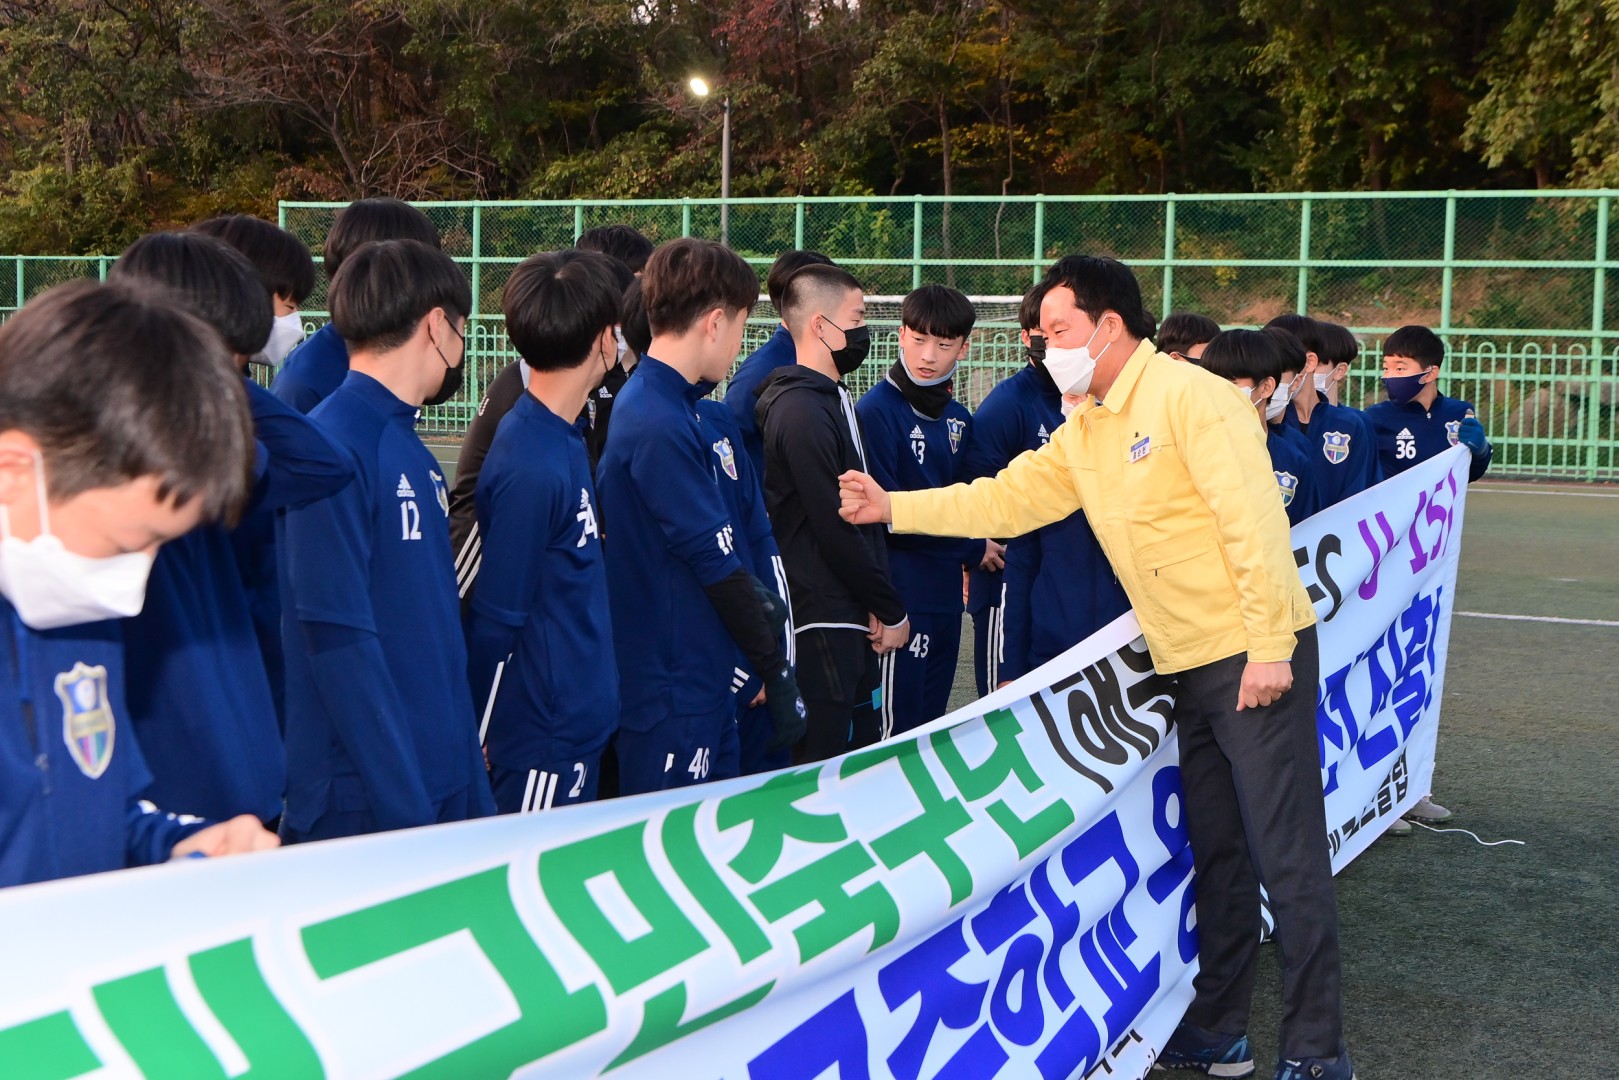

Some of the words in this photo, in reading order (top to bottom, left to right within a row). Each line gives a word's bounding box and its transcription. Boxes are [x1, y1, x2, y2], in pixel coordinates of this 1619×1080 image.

[1395, 440, 1417, 460] 36
[400, 500, 422, 540] 12
[909, 633, 930, 658] 43
[568, 762, 588, 798] 2
[688, 747, 710, 780] 46
